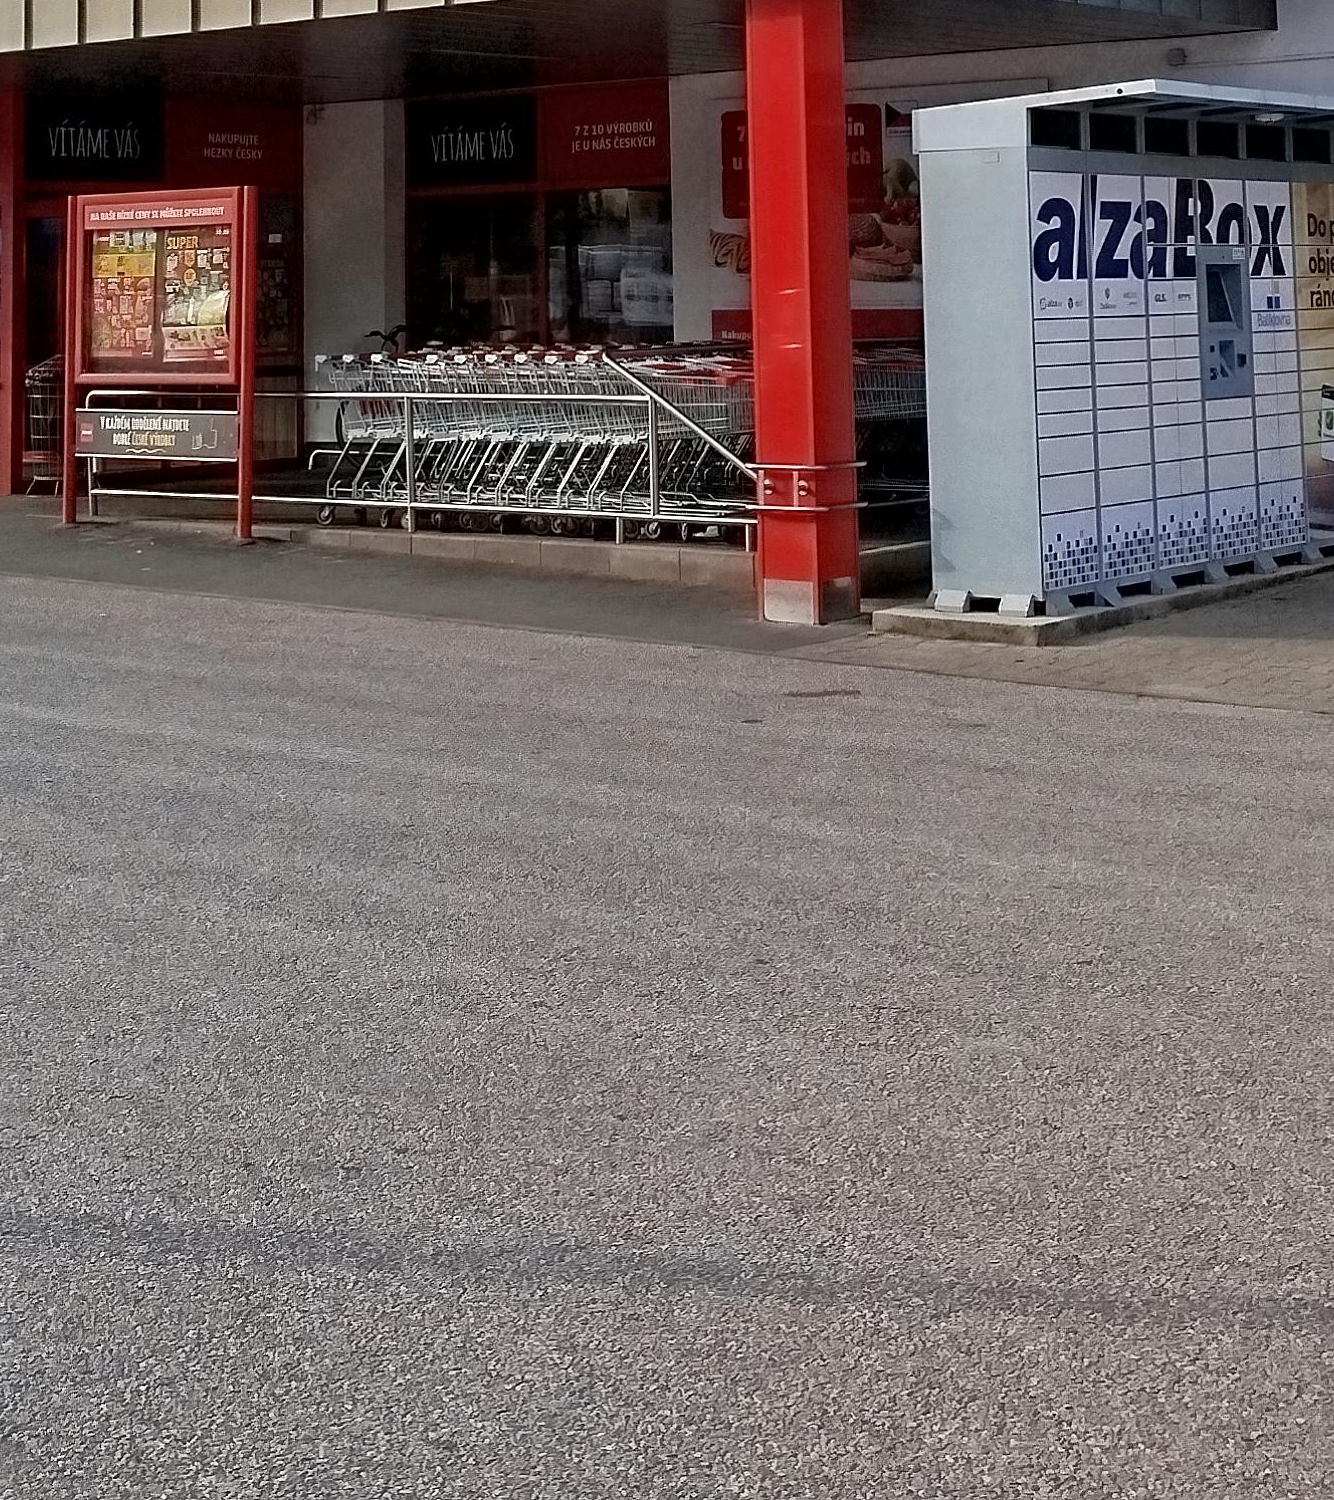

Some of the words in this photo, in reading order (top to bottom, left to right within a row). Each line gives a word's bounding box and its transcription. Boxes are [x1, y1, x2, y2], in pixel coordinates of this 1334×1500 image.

[574, 126, 581, 136] 7
[583, 125, 589, 136] Z
[591, 124, 604, 136] 10
[606, 118, 653, 134] VÝROBKŮ
[48, 119, 110, 159] VÍTÁME
[114, 120, 140, 159] VÁS
[207, 132, 259, 146] NAKUPUJTE
[431, 126, 486, 163] VÍTÁME
[489, 122, 514, 160] VÁS
[571, 141, 581, 153] JE
[582, 140, 590, 150] U
[592, 136, 612, 150] NÁS
[613, 134, 656, 149] ČESKÝCH
[203, 148, 233, 159] HEZKY
[235, 146, 263, 160] ČESKY
[1033, 174, 1287, 282] alzaBox
[1307, 212, 1326, 238] Do
[167, 236, 199, 249] SUPER
